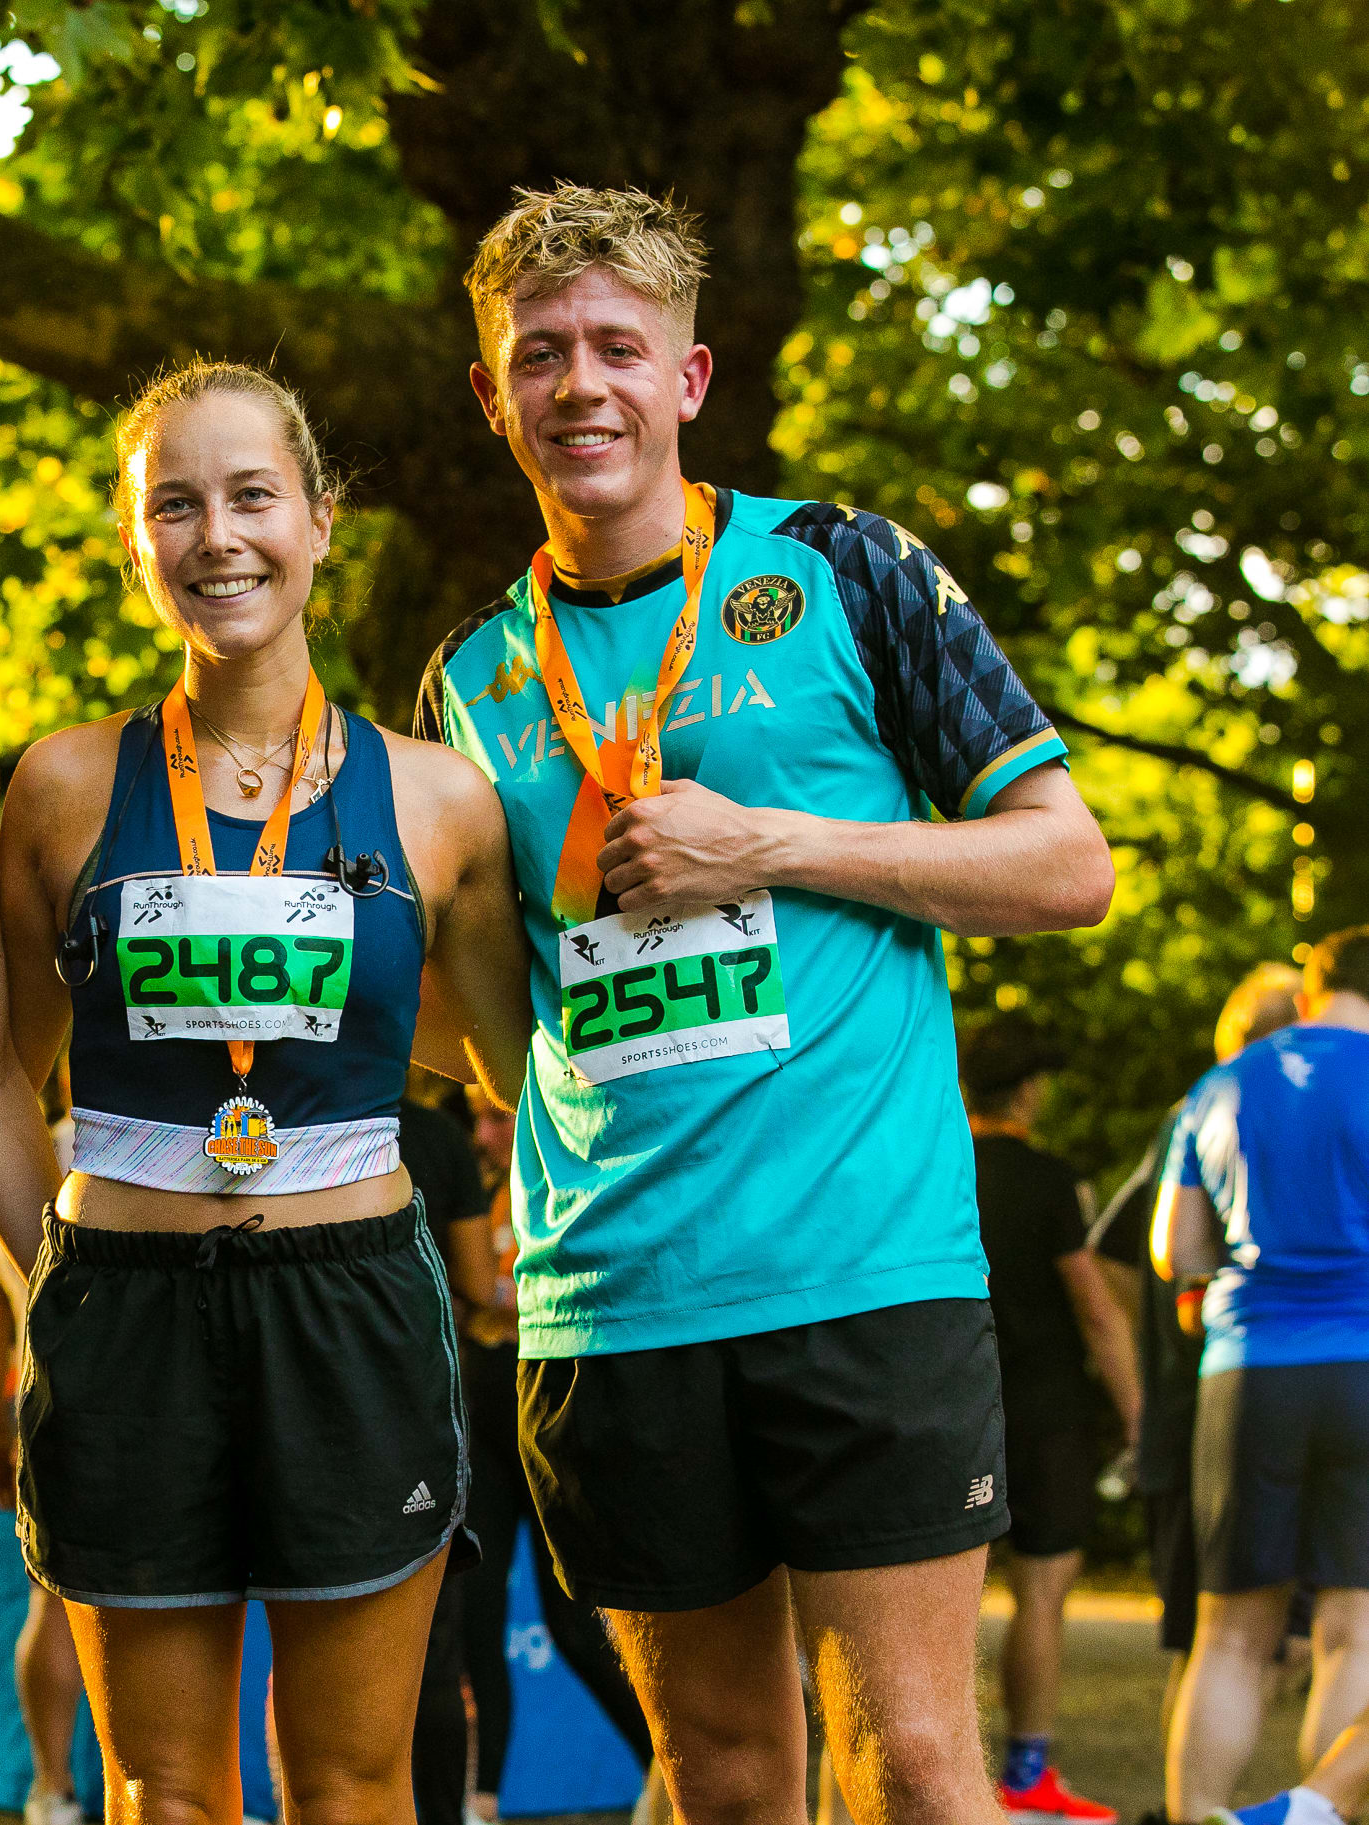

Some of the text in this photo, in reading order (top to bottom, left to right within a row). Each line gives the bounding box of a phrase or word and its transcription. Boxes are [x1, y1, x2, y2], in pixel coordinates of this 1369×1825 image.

[737, 577, 788, 594] VENEZIA
[133, 900, 184, 911] RunThrough
[284, 900, 337, 912] RunThrough
[633, 922, 684, 940] RunThrough
[748, 928, 761, 937] KIT
[127, 936, 345, 1004] 2487
[595, 958, 605, 966] KIT
[569, 947, 771, 1051] 2547
[621, 1036, 728, 1065] SPORTSSHOES.COM
[208, 1137, 277, 1157] CHASE THE SUN
[402, 1499, 436, 1514] adidas
